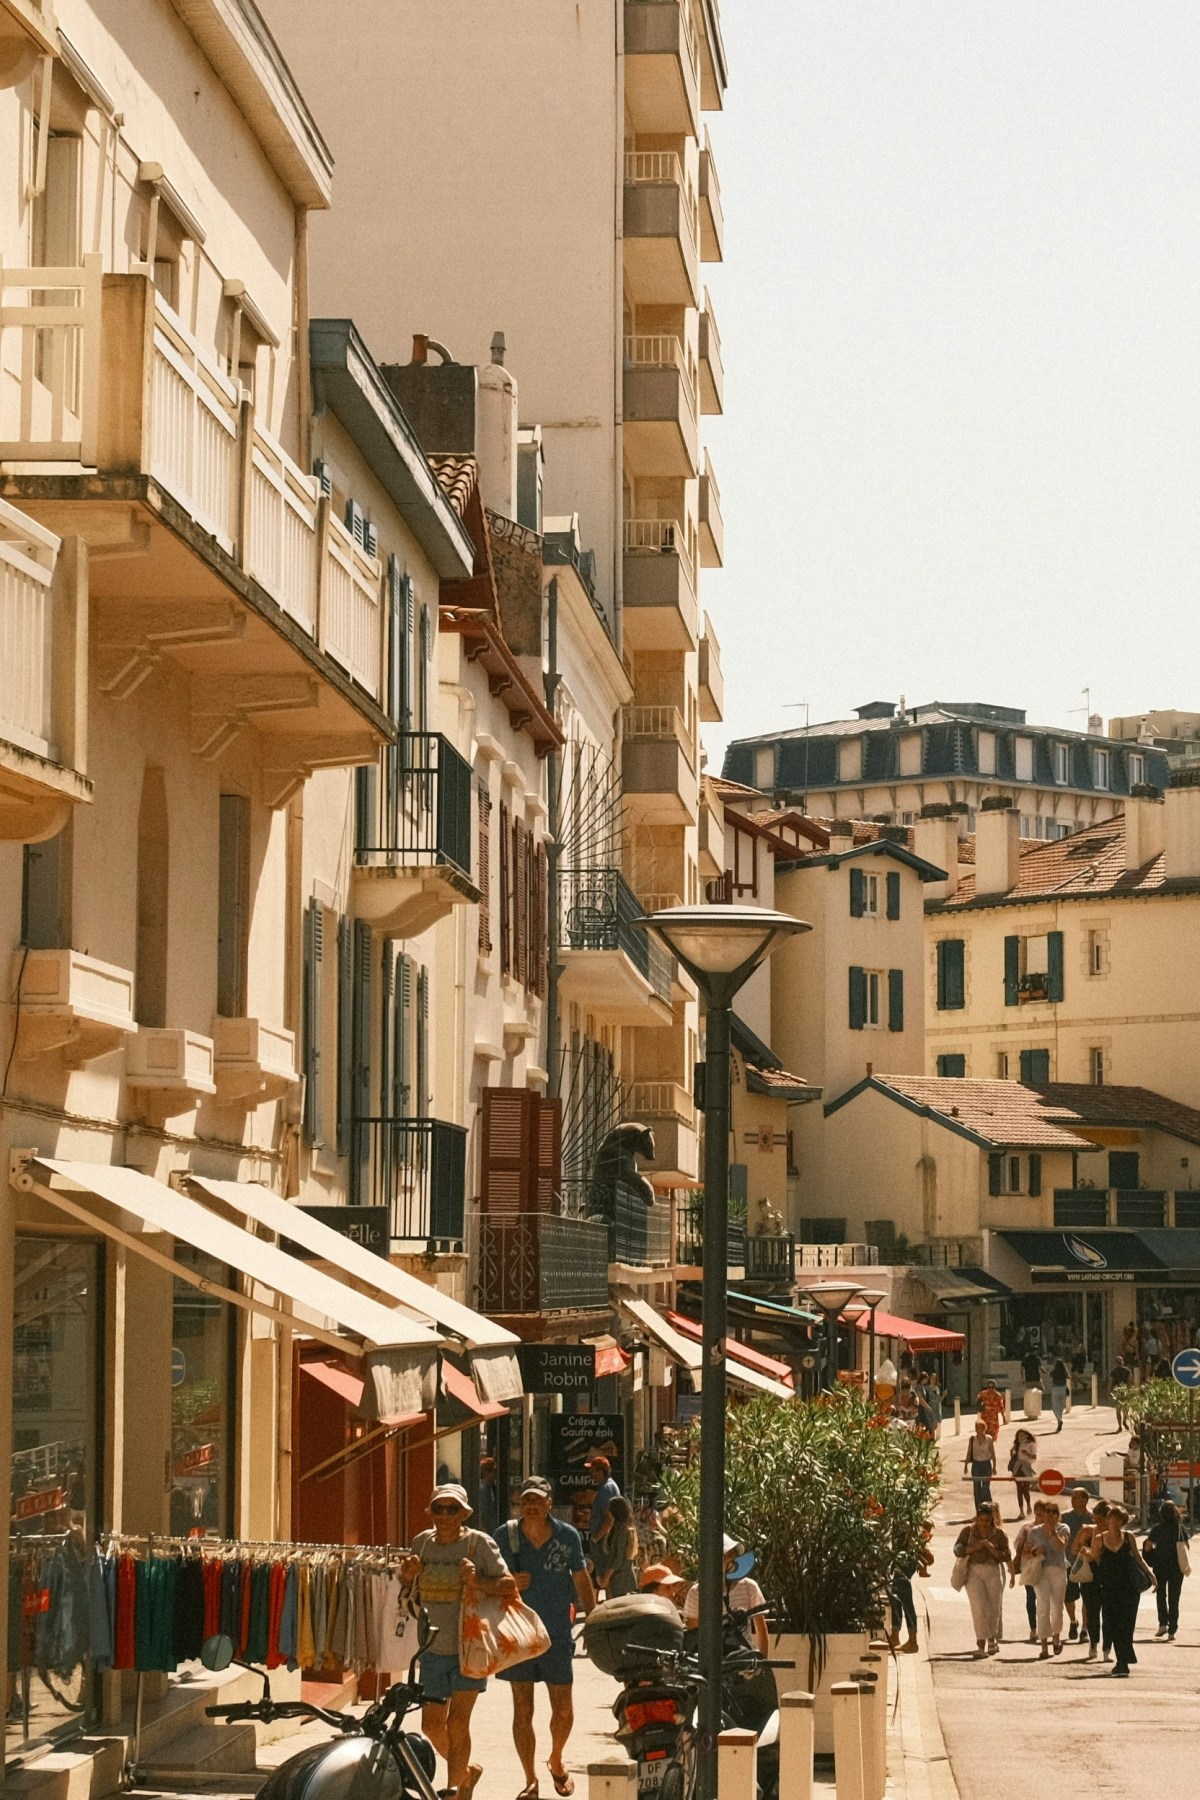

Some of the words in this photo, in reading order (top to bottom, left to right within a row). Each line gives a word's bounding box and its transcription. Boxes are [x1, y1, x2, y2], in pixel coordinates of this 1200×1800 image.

[540, 1352, 592, 1366] Janine
[544, 1372, 588, 1386] Robin
[598, 1416, 606, 1426] &
[560, 1427, 594, 1437] Gaufre
[647, 1762, 661, 1774] DF
